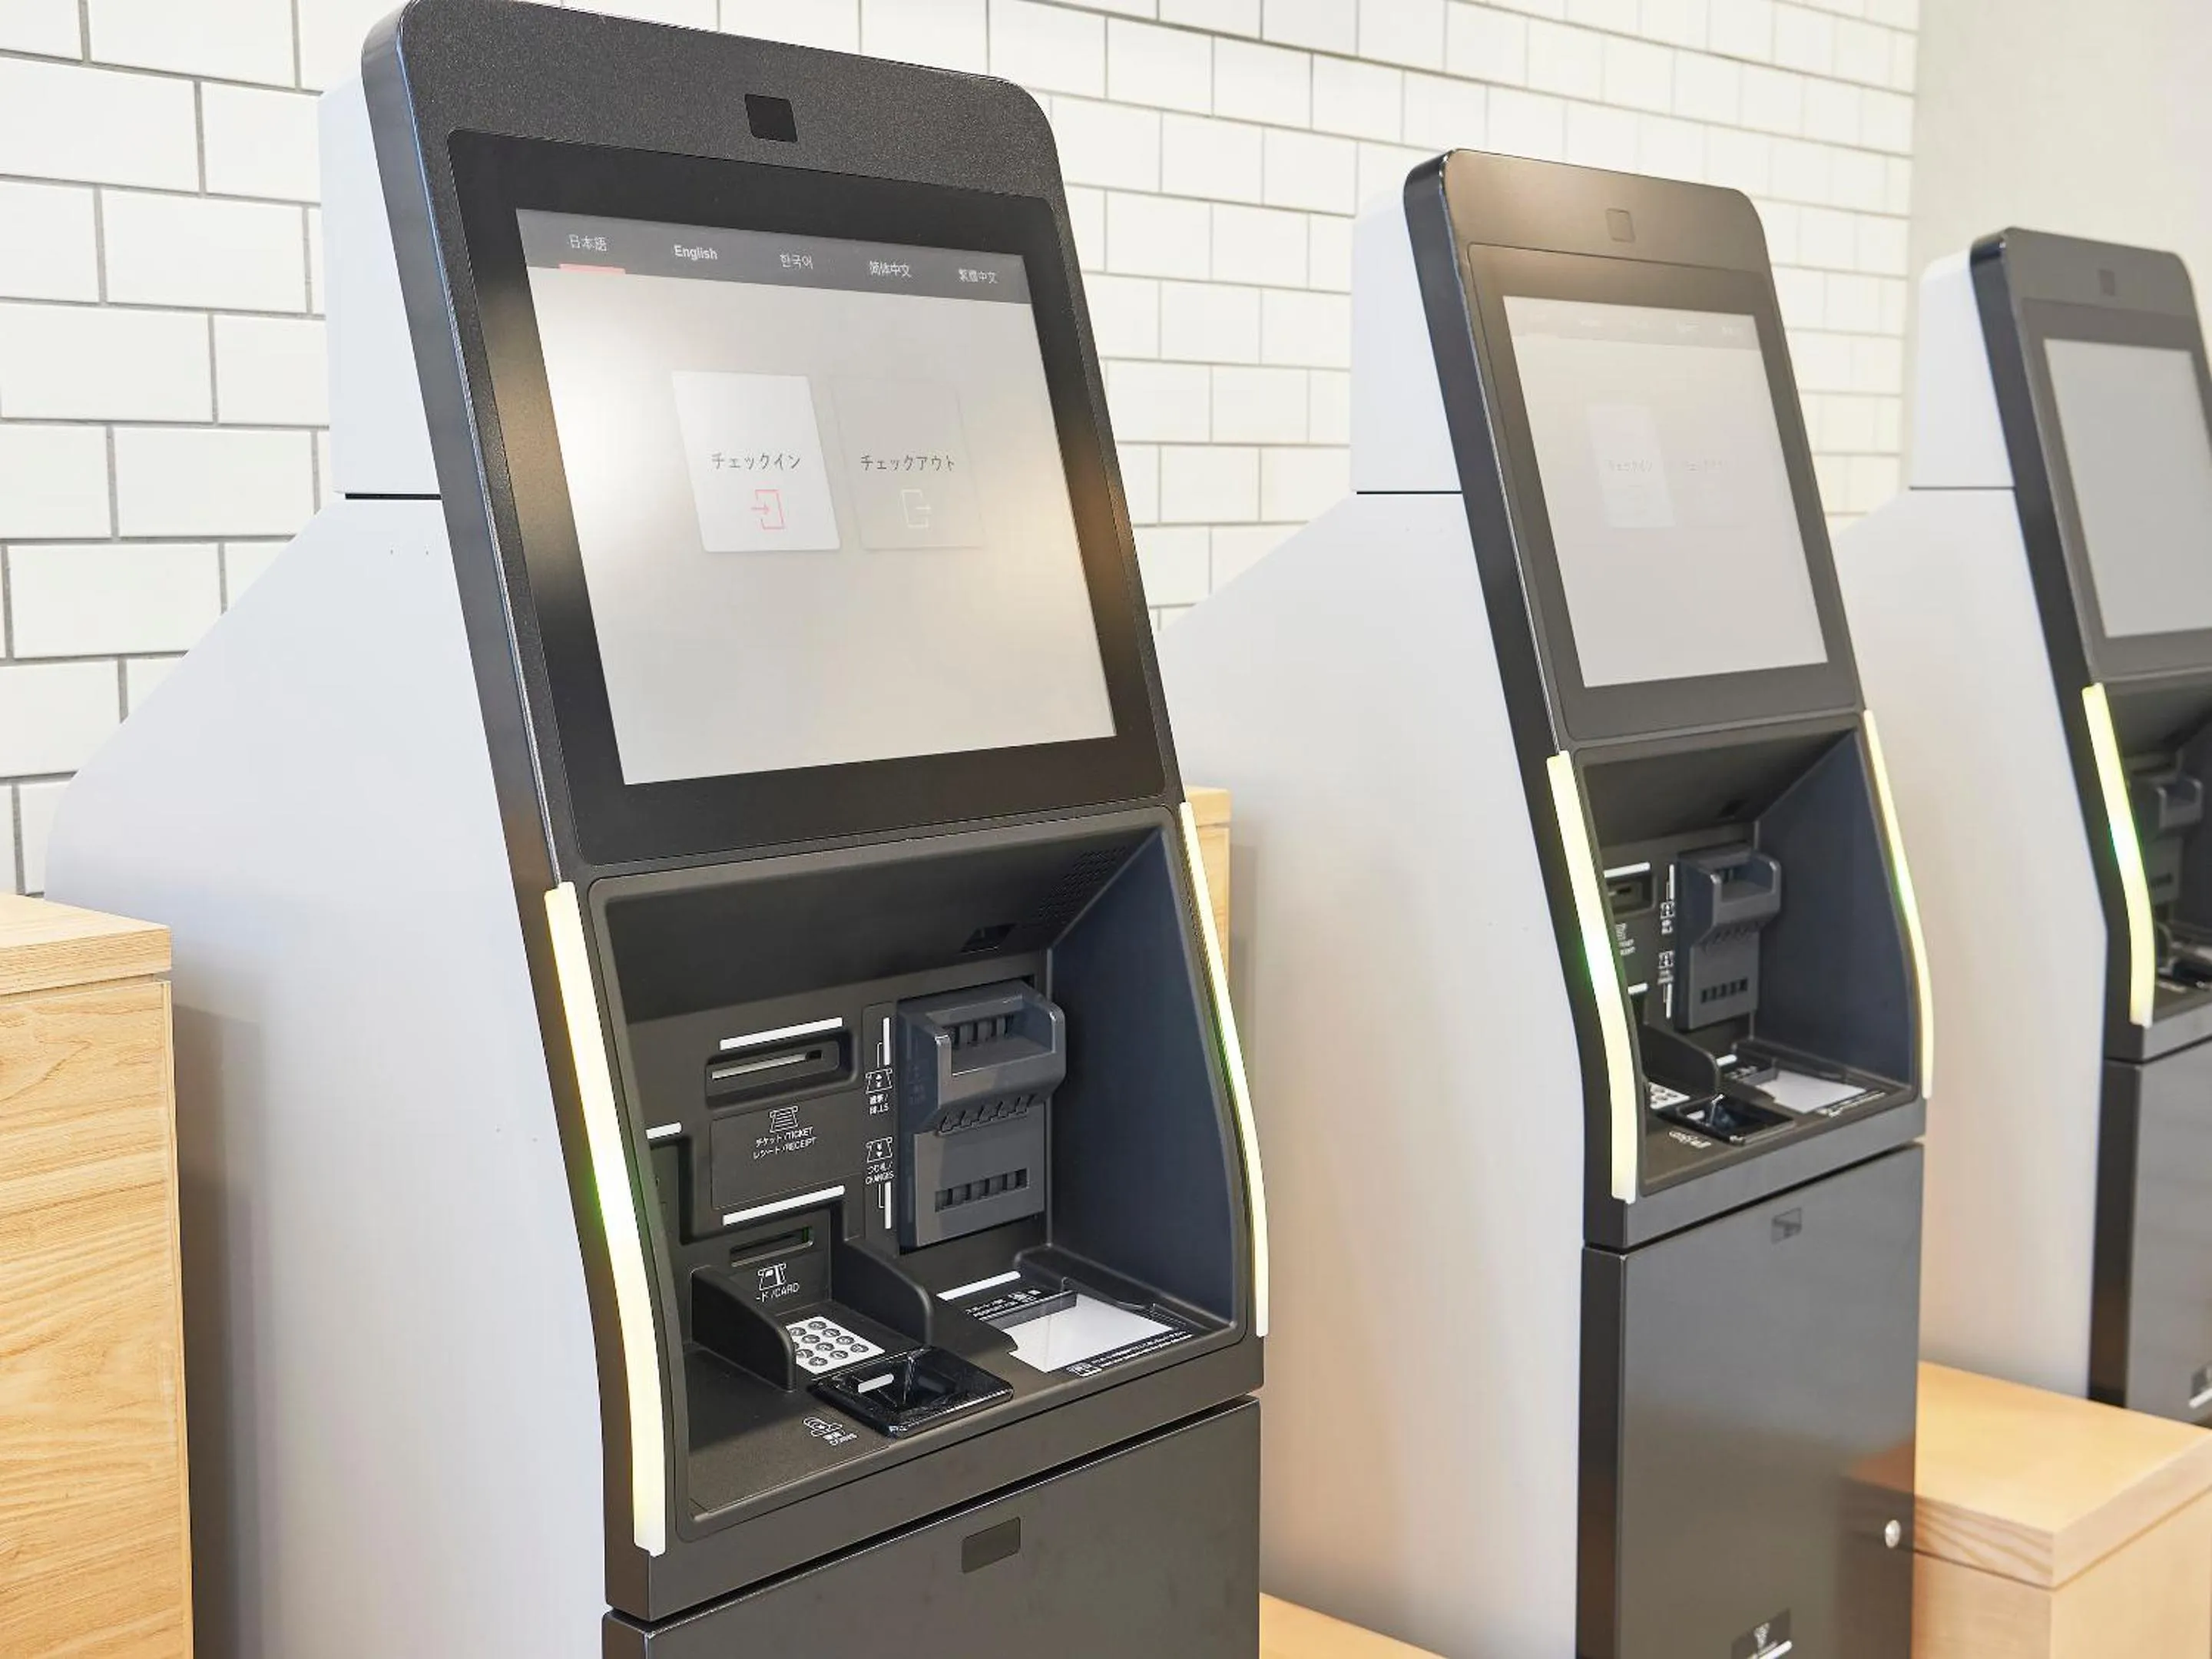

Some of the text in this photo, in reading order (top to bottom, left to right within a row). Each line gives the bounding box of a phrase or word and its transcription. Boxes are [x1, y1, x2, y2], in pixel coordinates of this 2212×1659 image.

[568, 233, 608, 252] 日本語
[673, 243, 719, 261] English
[779, 252, 813, 270] 한국어
[711, 452, 800, 470] チェックイン
[860, 453, 955, 472] チェックアウト
